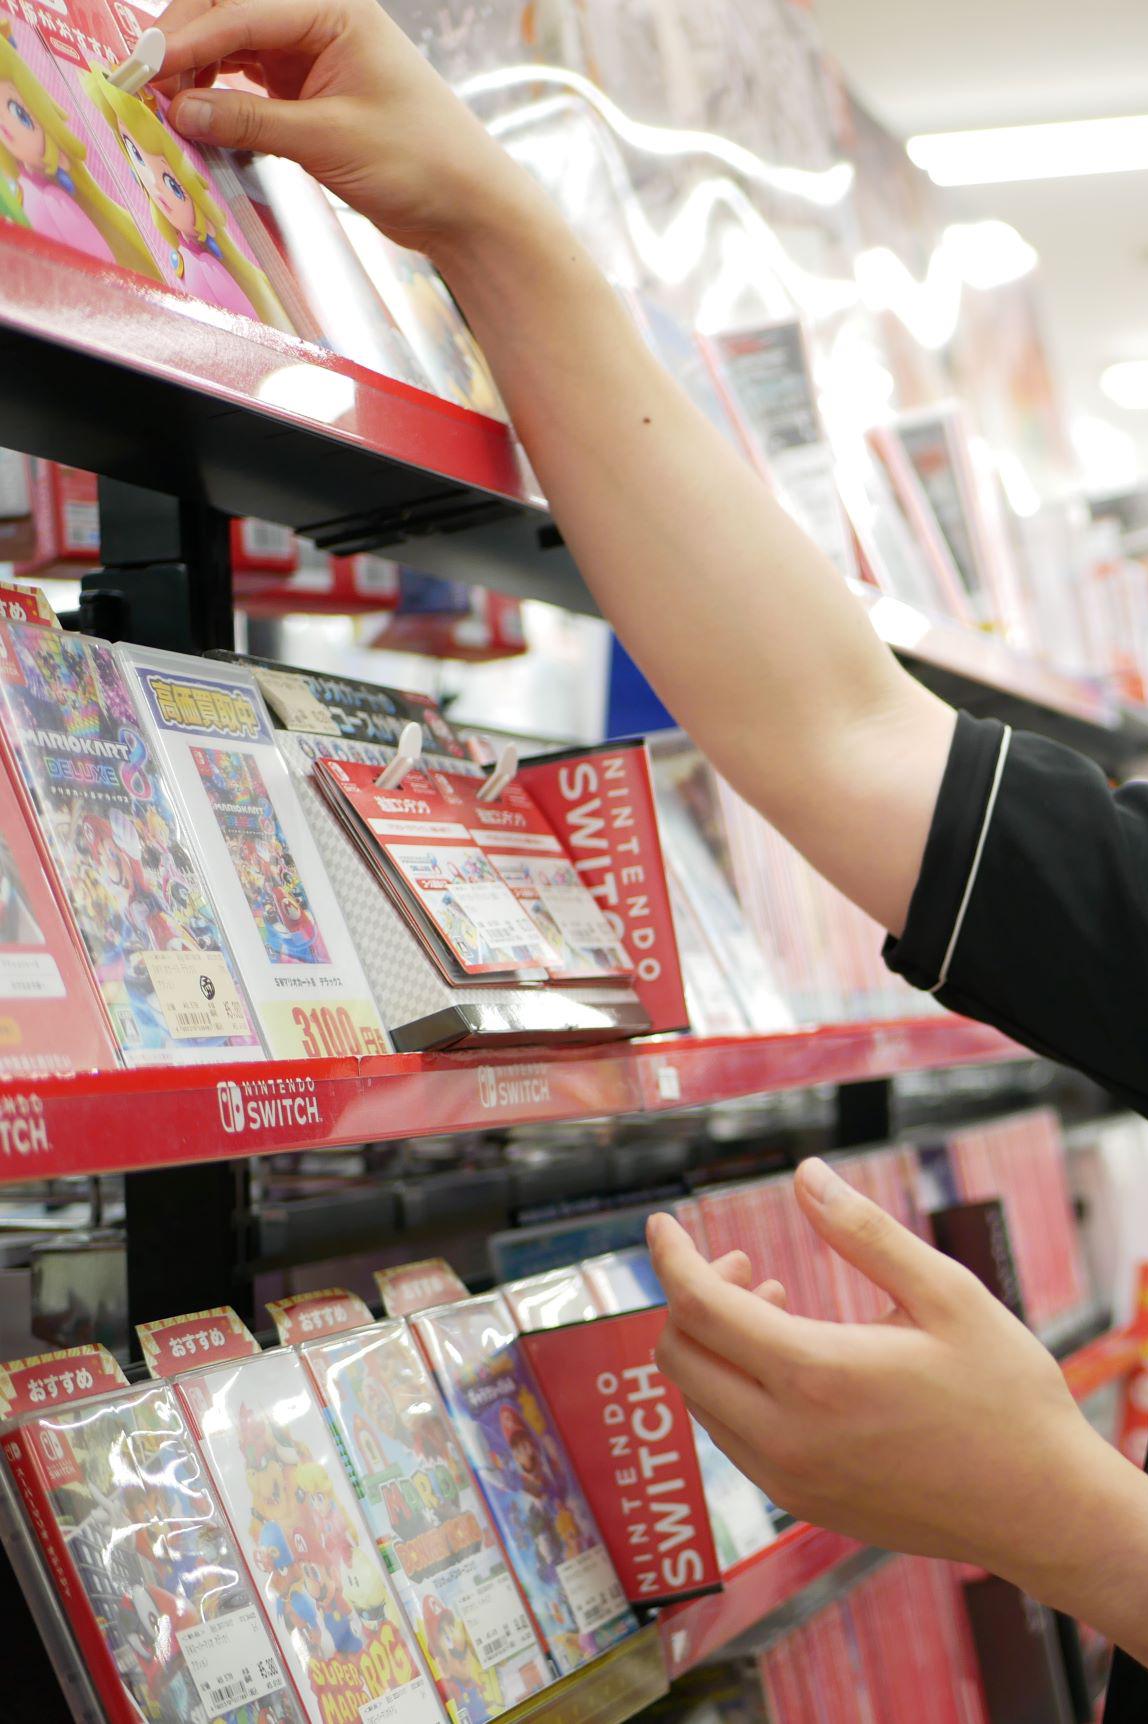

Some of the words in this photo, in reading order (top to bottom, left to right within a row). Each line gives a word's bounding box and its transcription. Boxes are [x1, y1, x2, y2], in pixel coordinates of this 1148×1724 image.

[151, 680, 260, 736] 高価買取中
[44, 755, 120, 787] DELUXE
[602, 757, 661, 982] NINTENDO
[242, 1076, 315, 1097] NINTENDO
[500, 1080, 549, 1107] SWITCH
[247, 1096, 320, 1130] SWITCH
[298, 1303, 348, 1332] おすすめ
[168, 1327, 226, 1359] おすすめ
[27, 1366, 94, 1403] おすすめ
[597, 1371, 661, 1593] NINTENDO
[622, 1362, 704, 1588] SWITCH
[309, 1657, 362, 1687] SUPER
